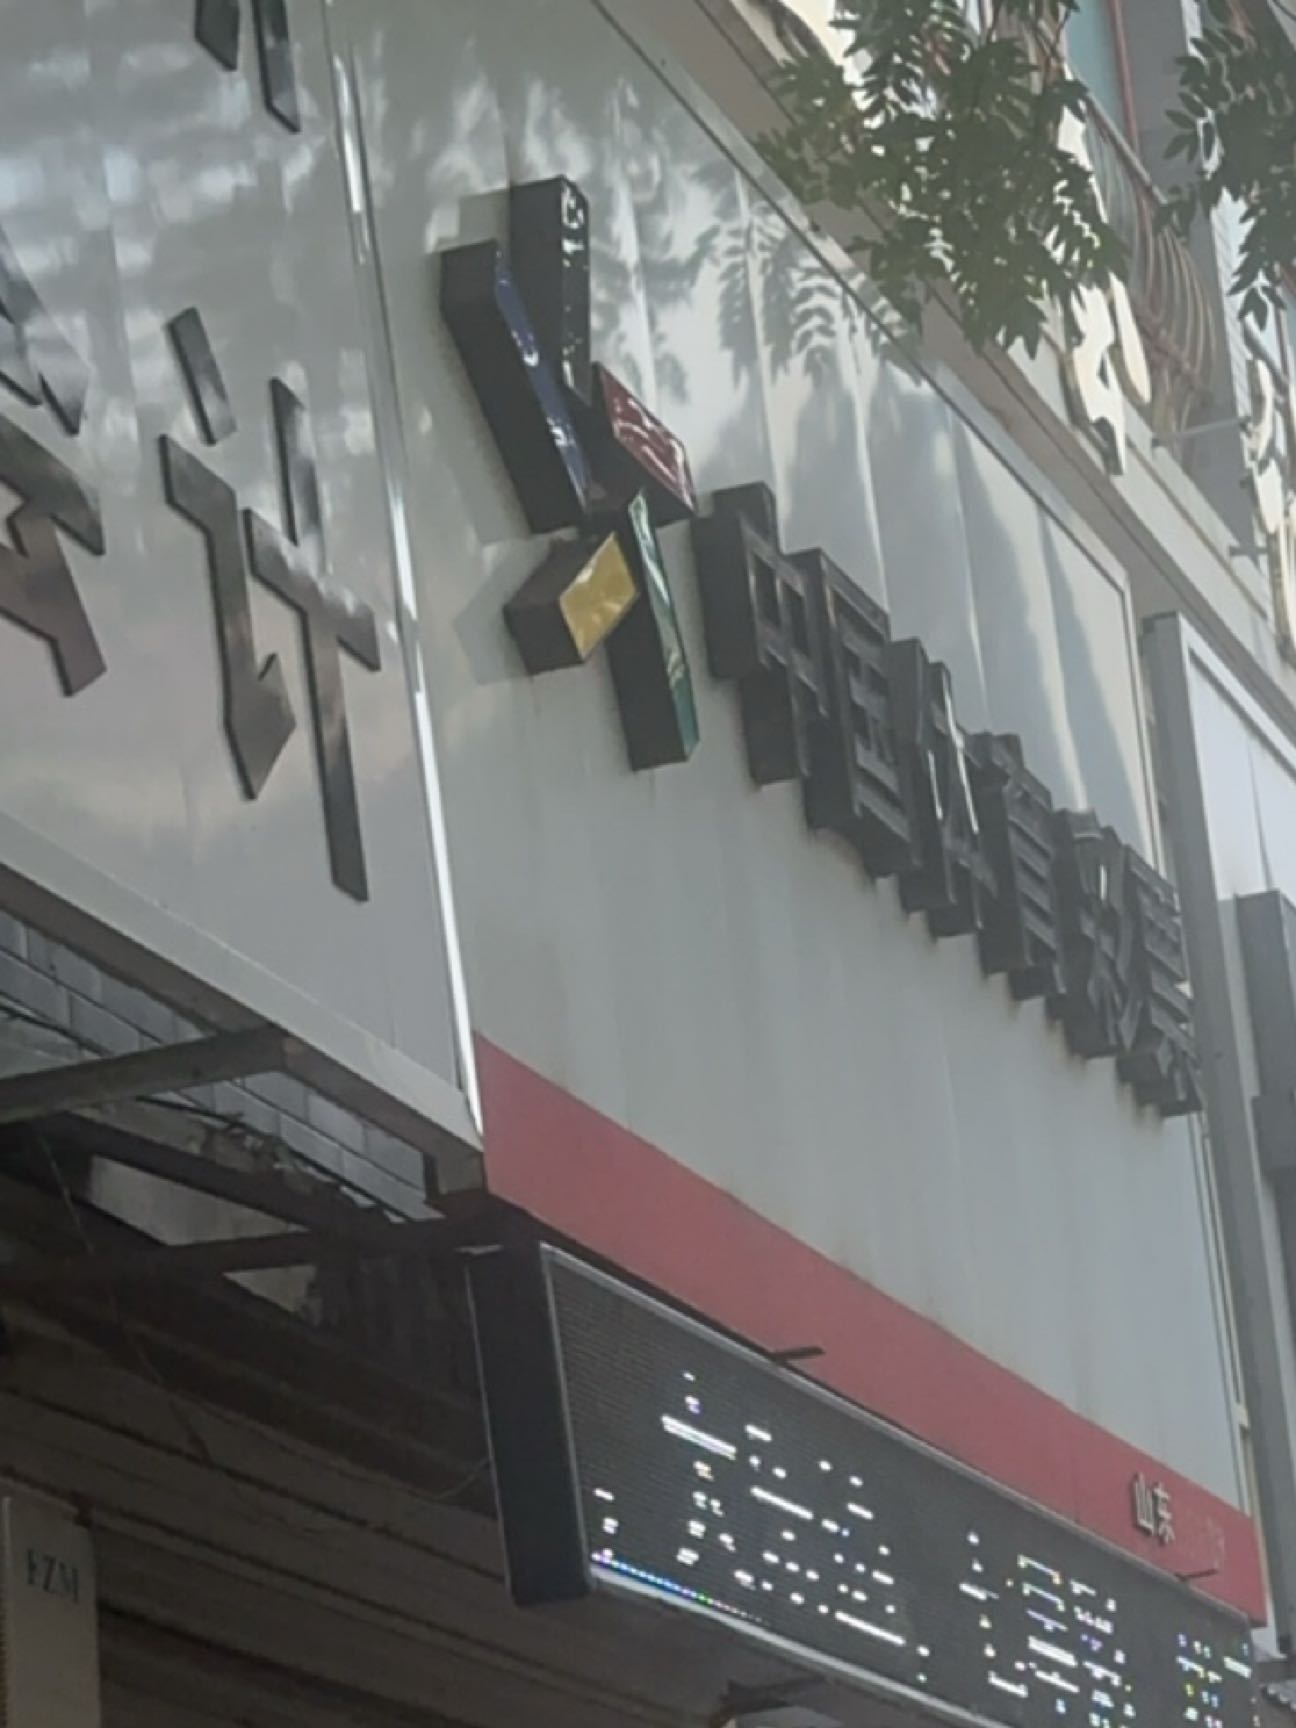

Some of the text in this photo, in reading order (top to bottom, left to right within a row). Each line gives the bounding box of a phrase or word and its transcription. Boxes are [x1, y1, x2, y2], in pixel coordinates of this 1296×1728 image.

[690, 481, 1203, 1117] 中国体育彩票
[1131, 1470, 1176, 1546] 山东
